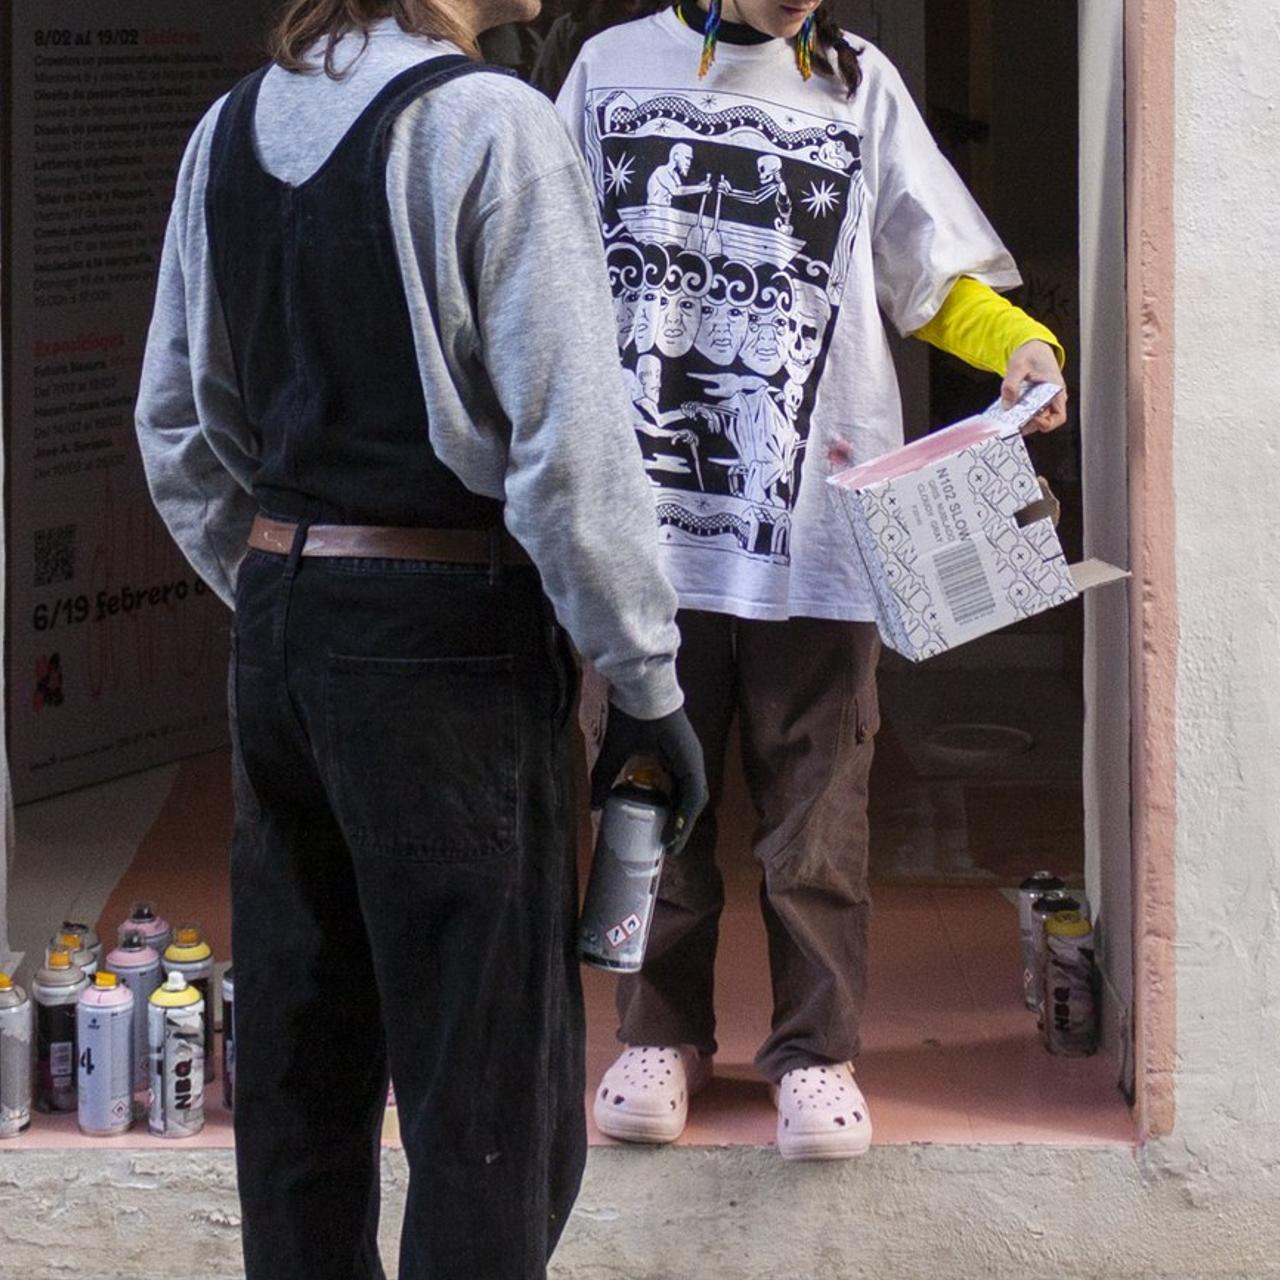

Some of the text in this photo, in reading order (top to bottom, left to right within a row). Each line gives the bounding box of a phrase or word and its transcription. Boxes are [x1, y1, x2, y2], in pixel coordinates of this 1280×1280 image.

[34, 28, 71, 47] 8/02
[96, 28, 139, 46] 19/02
[935, 467, 973, 542] N102 SLOW
[33, 594, 89, 631] 6/19
[95, 580, 189, 621] febrero
[174, 1058, 193, 1111] NBQ
